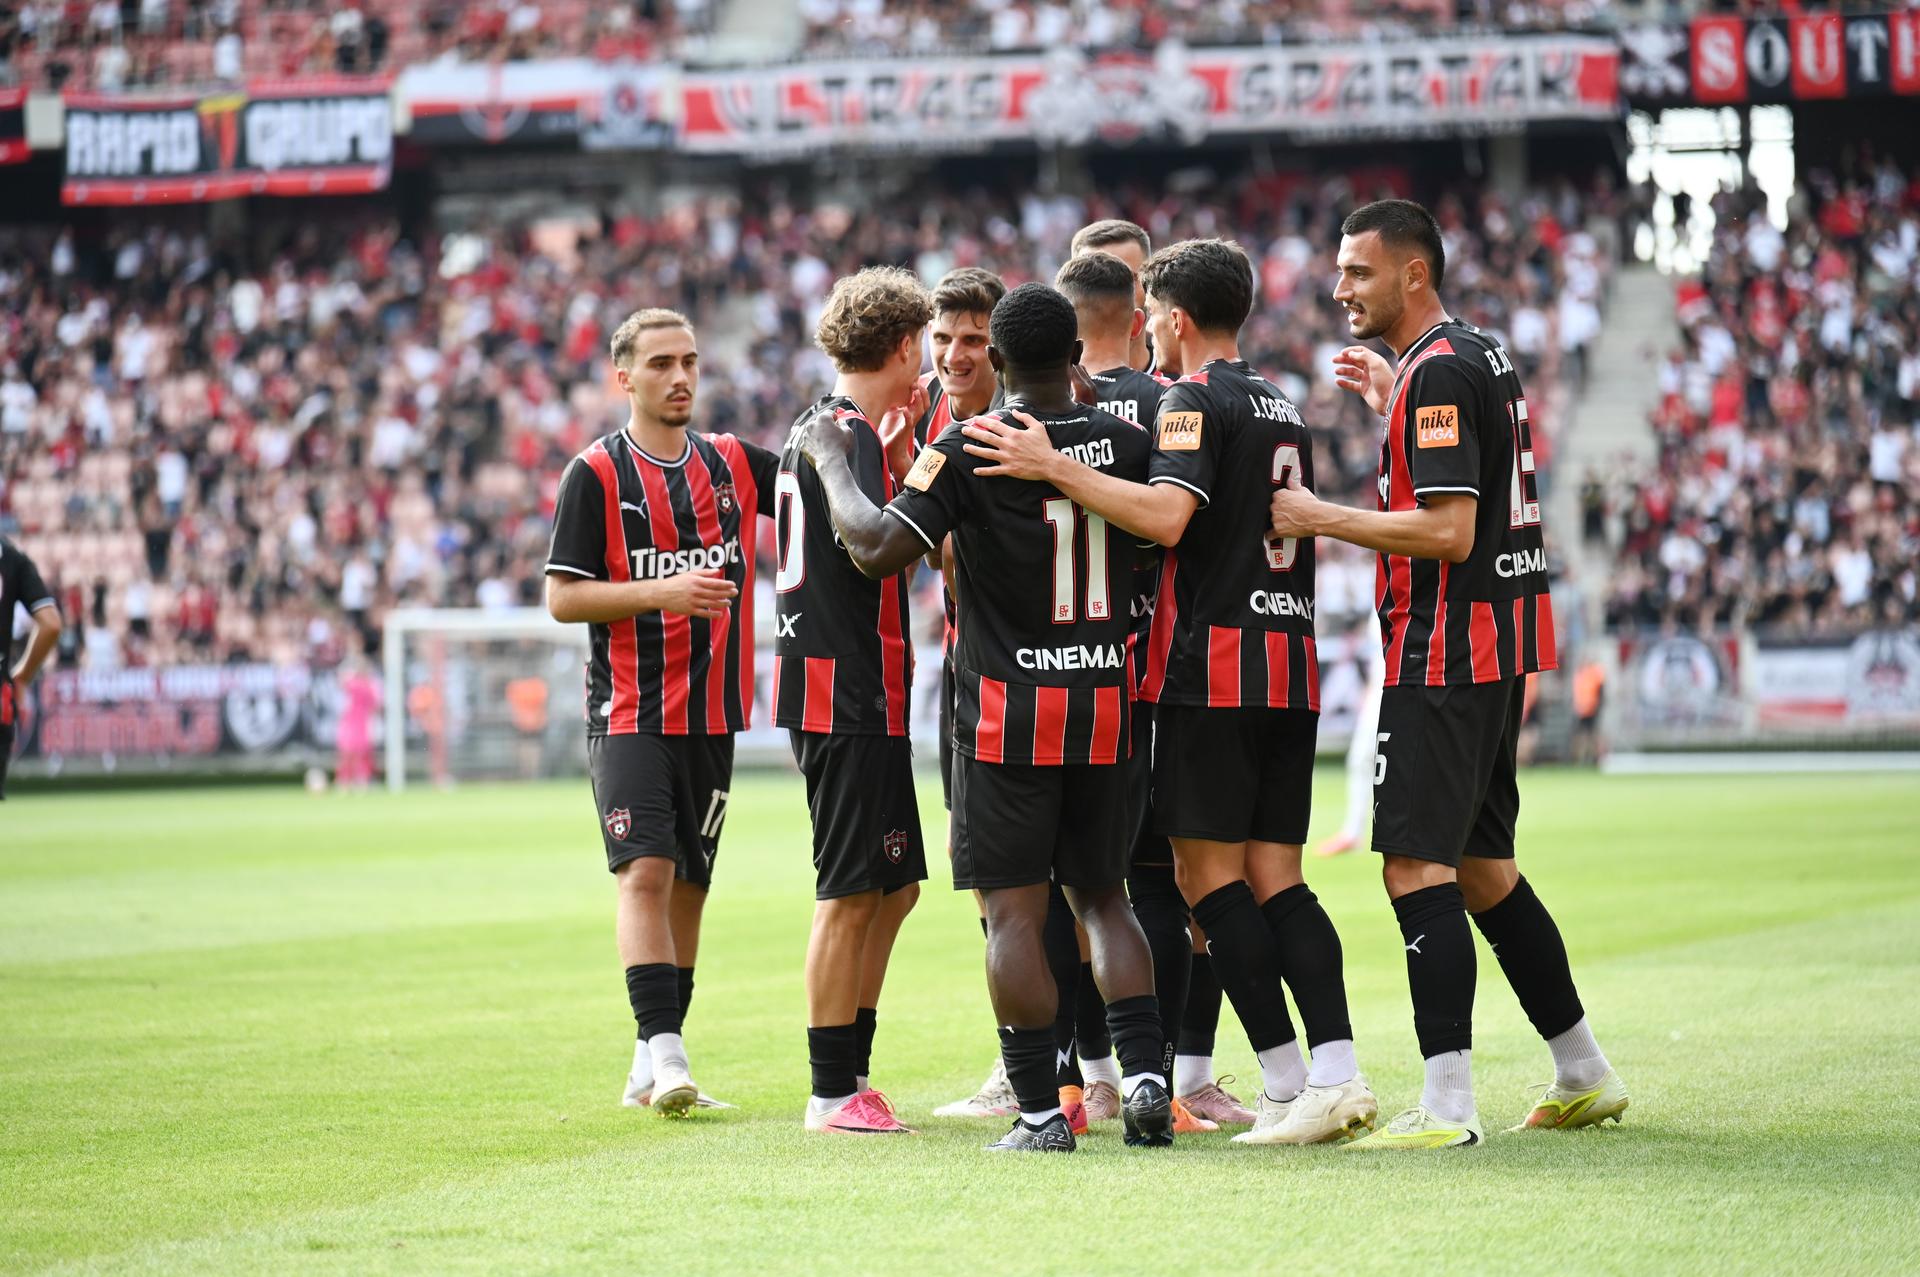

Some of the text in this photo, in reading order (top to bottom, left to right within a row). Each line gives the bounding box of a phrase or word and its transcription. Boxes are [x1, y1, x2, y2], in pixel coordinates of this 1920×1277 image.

[1164, 415, 1199, 433] niké
[1420, 409, 1454, 430] niké
[1164, 432, 1198, 445] LIGA
[1421, 427, 1456, 442] LIGA
[630, 534, 740, 581] Tipsport
[1042, 495, 1112, 625] 11
[700, 788, 730, 839] 17
